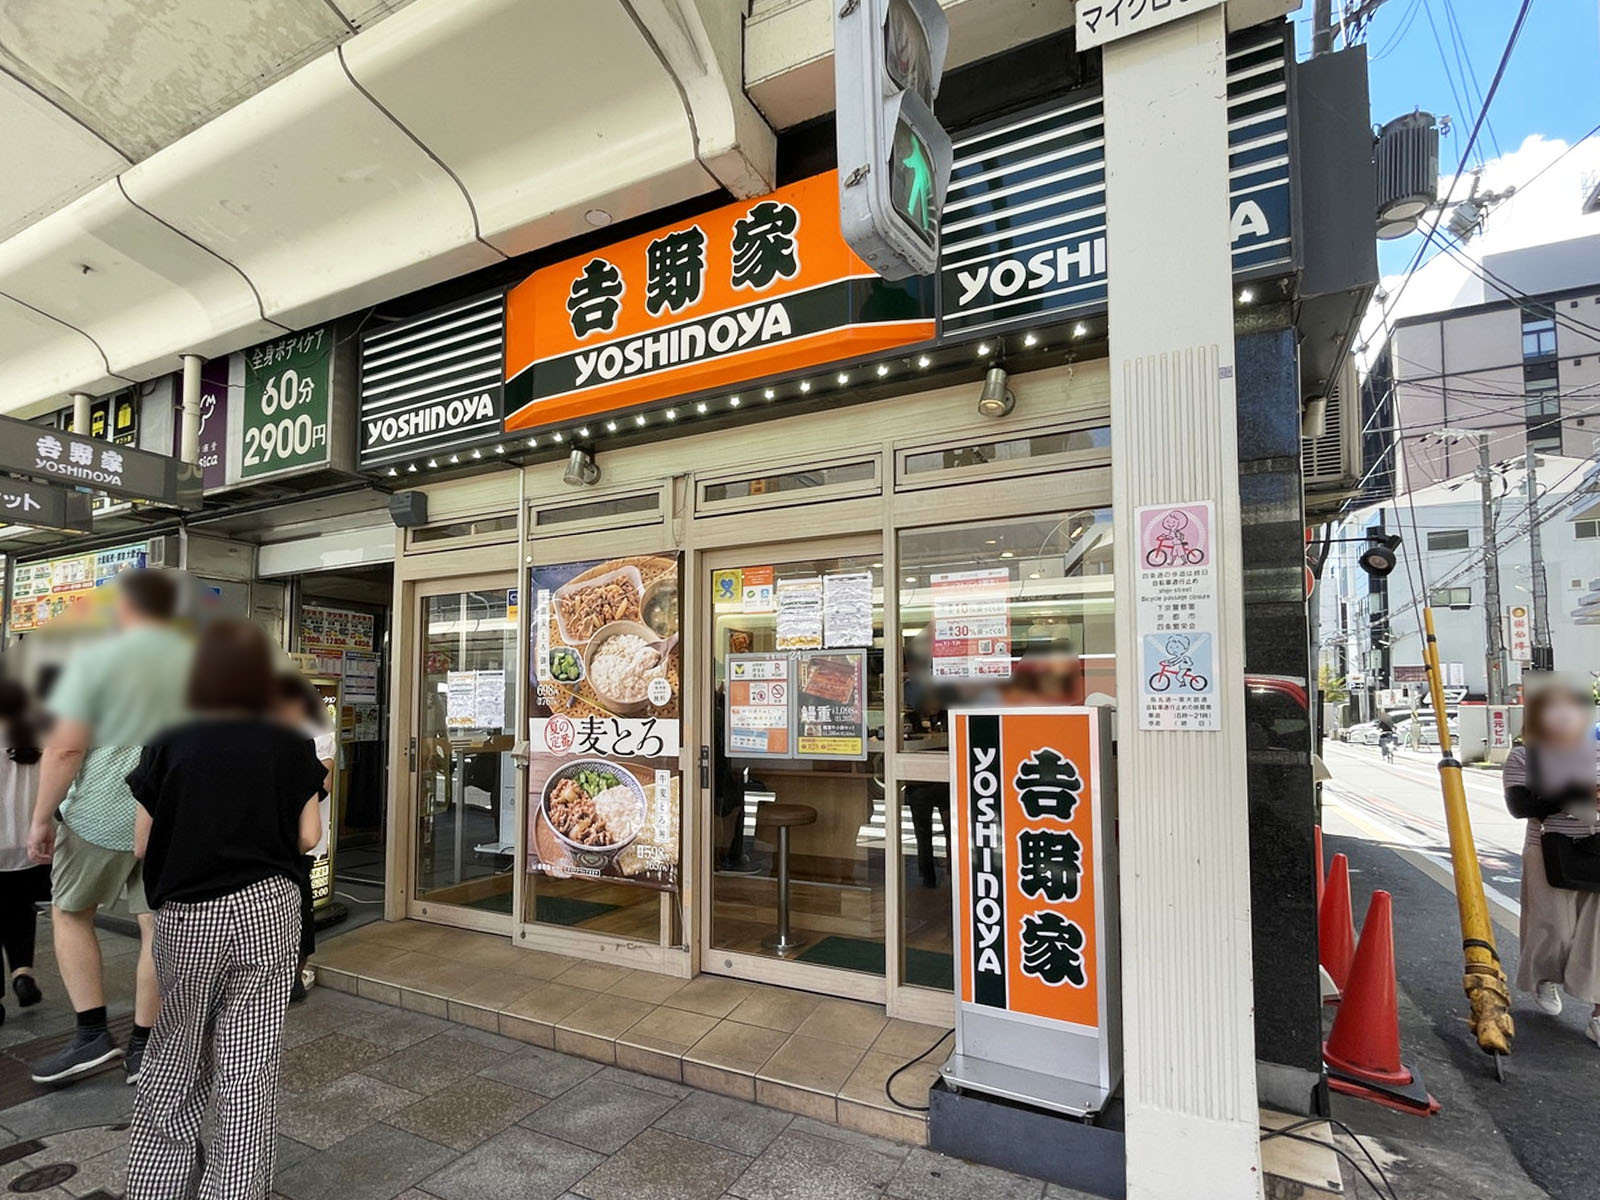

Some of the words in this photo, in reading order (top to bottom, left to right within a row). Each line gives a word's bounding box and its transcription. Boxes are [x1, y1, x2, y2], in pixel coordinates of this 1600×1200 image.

[568, 202, 800, 339] 吉野家
[575, 303, 792, 386] YOSHINOYA
[261, 369, 315, 415] 60分
[244, 414, 326, 466] 2900円
[367, 393, 494, 446] YOSHINOYA
[35, 457, 123, 486] YOSHINOYA
[36, 435, 123, 474] 吉野家
[0, 491, 41, 511] ット
[577, 715, 664, 757] 麦とろ
[973, 748, 1002, 975] YOSHINOYA
[1013, 747, 1087, 989] 吉野家
